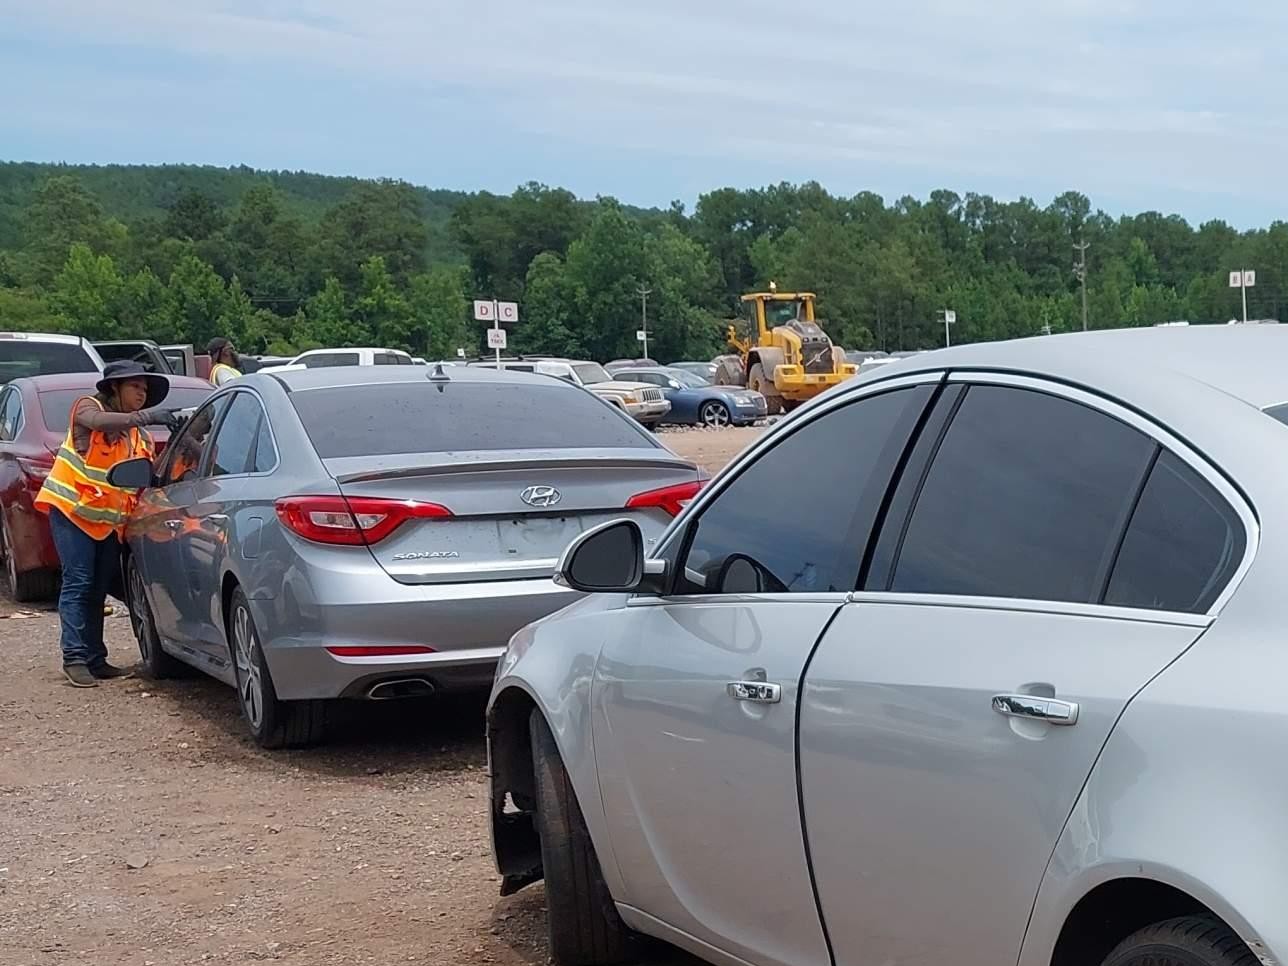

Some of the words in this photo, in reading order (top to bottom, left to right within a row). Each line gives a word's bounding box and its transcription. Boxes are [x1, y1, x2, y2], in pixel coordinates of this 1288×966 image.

[480, 305, 489, 316] D
[504, 306, 513, 318] C
[392, 551, 460, 561] SONATA
